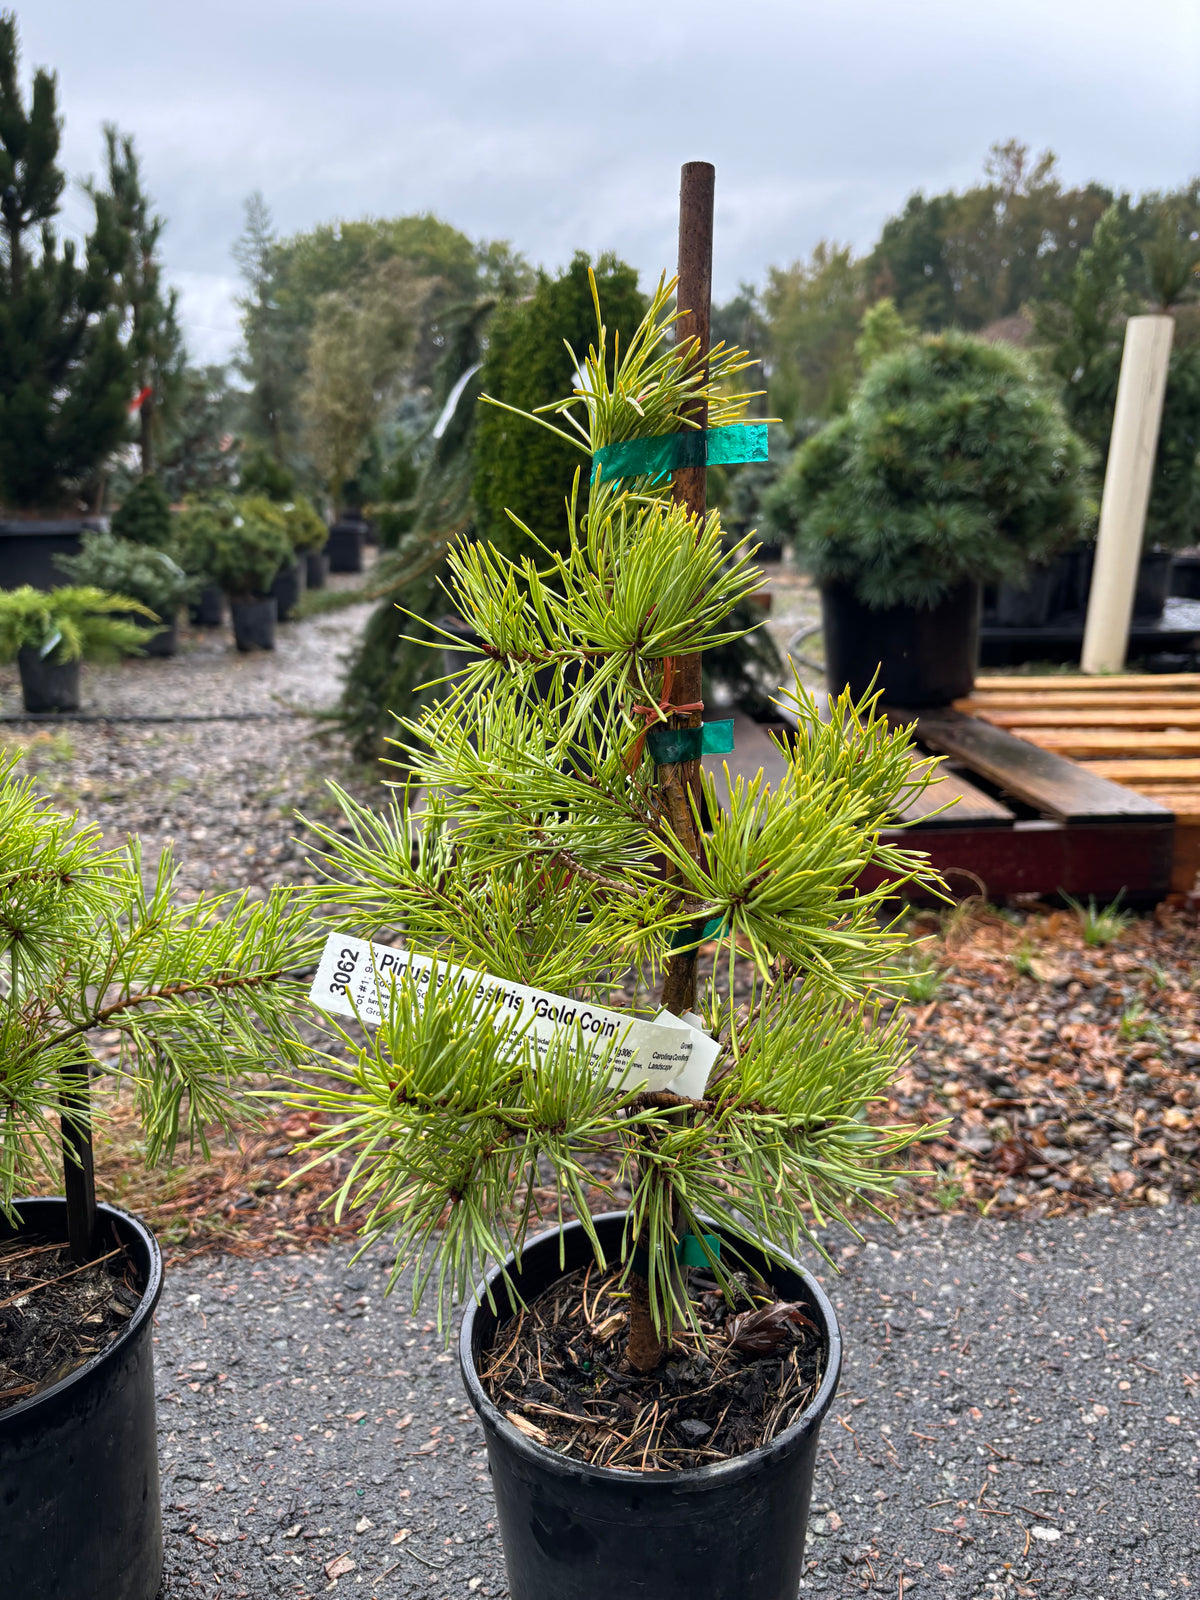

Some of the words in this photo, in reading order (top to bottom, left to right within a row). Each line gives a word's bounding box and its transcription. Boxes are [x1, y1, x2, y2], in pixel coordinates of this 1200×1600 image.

[330, 948, 360, 996] 3062
[379, 953, 431, 983] Pinus
[437, 973, 523, 1011] slestris
[531, 996, 576, 1026] 'Gold
[580, 1011, 620, 1038] Coin'
